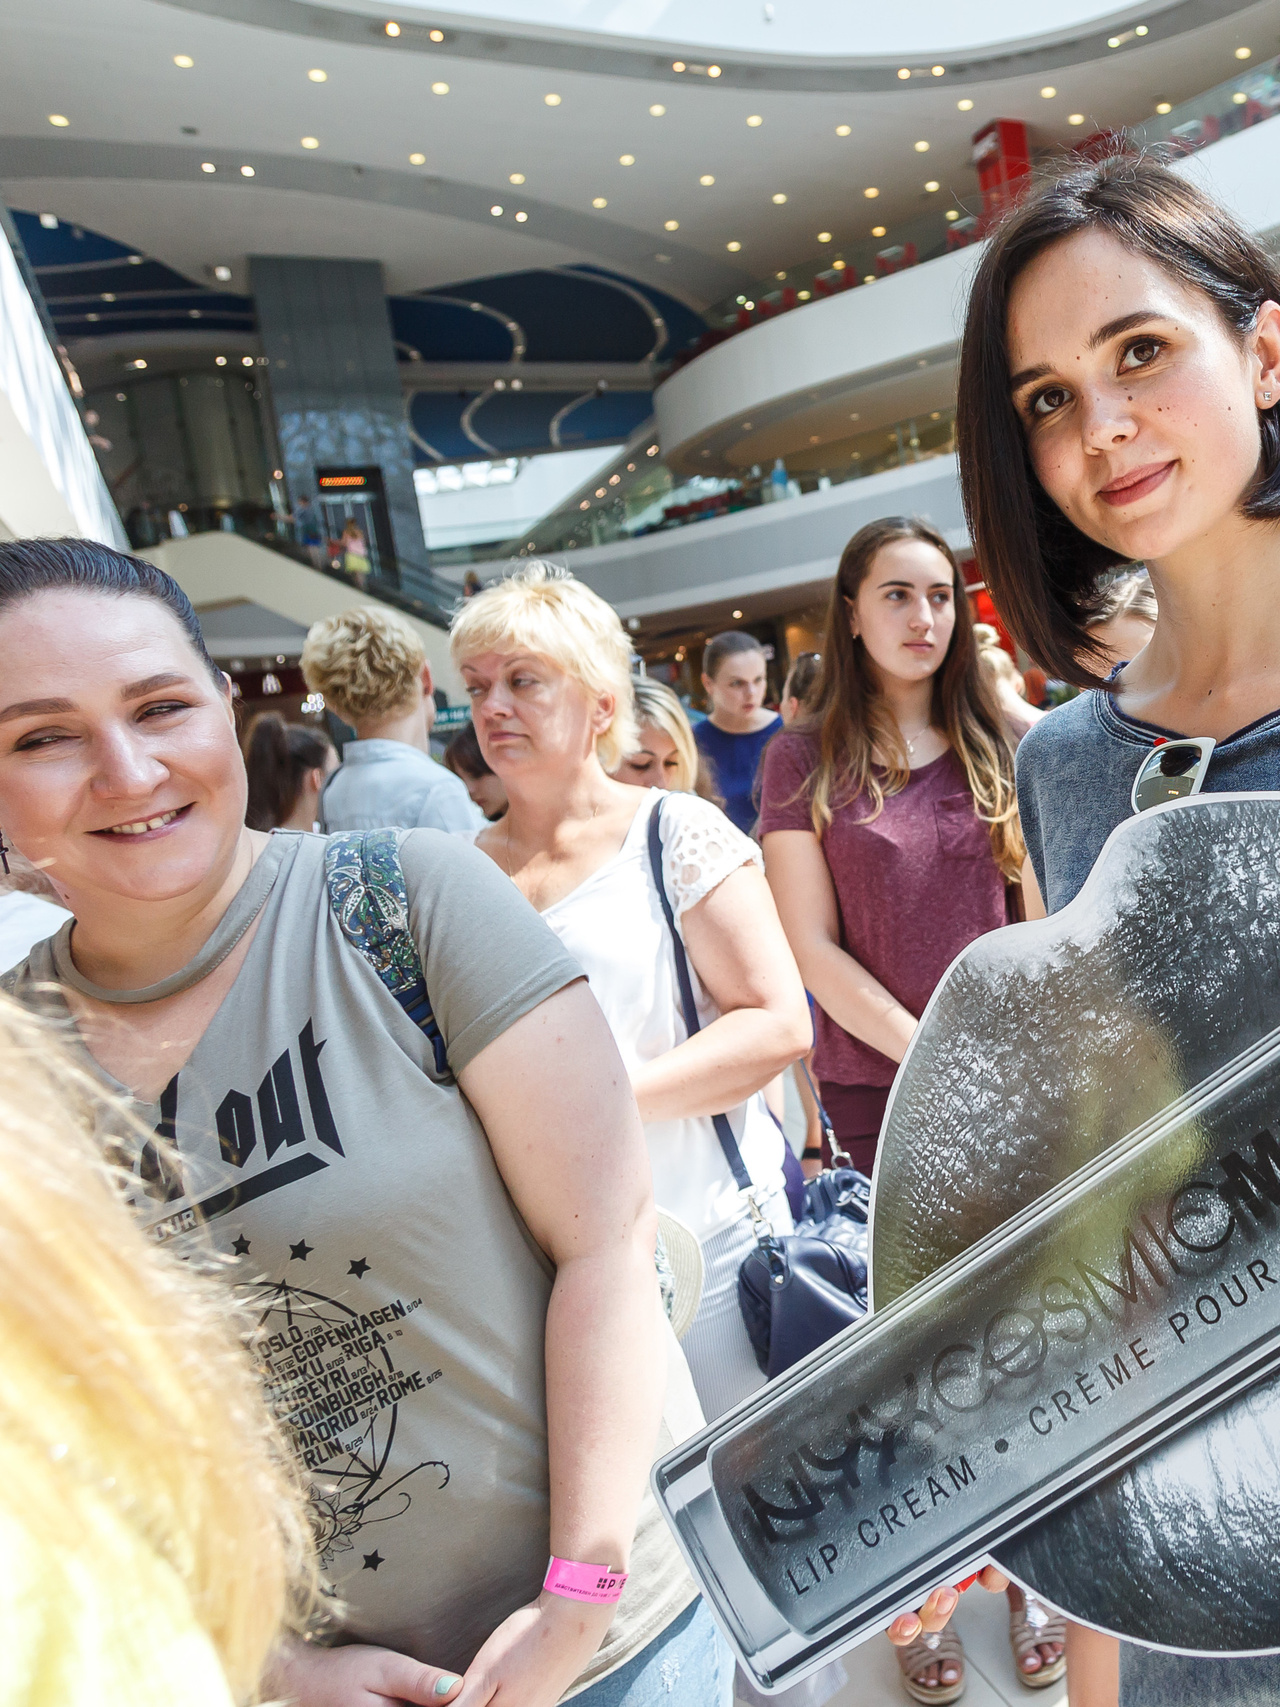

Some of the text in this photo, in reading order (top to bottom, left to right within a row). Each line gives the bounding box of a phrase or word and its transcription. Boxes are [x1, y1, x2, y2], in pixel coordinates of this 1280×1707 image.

[215, 1016, 346, 1168] out
[153, 1209, 197, 1241] OUR
[257, 1325, 304, 1359] OSLO
[291, 1299, 407, 1363] COPENHAGEN
[341, 1329, 387, 1358] RIGA
[273, 1366, 351, 1419] KUREYRI
[288, 1368, 387, 1430] EDINBURGH
[292, 1405, 359, 1453] MADRID
[375, 1371, 426, 1409] ROME
[293, 1437, 344, 1470] ERLIN
[786, 1543, 838, 1596] LIP
[857, 1455, 978, 1549] CREAM
[1028, 1337, 1156, 1436] CRÈME
[1167, 1258, 1278, 1345] POUR
